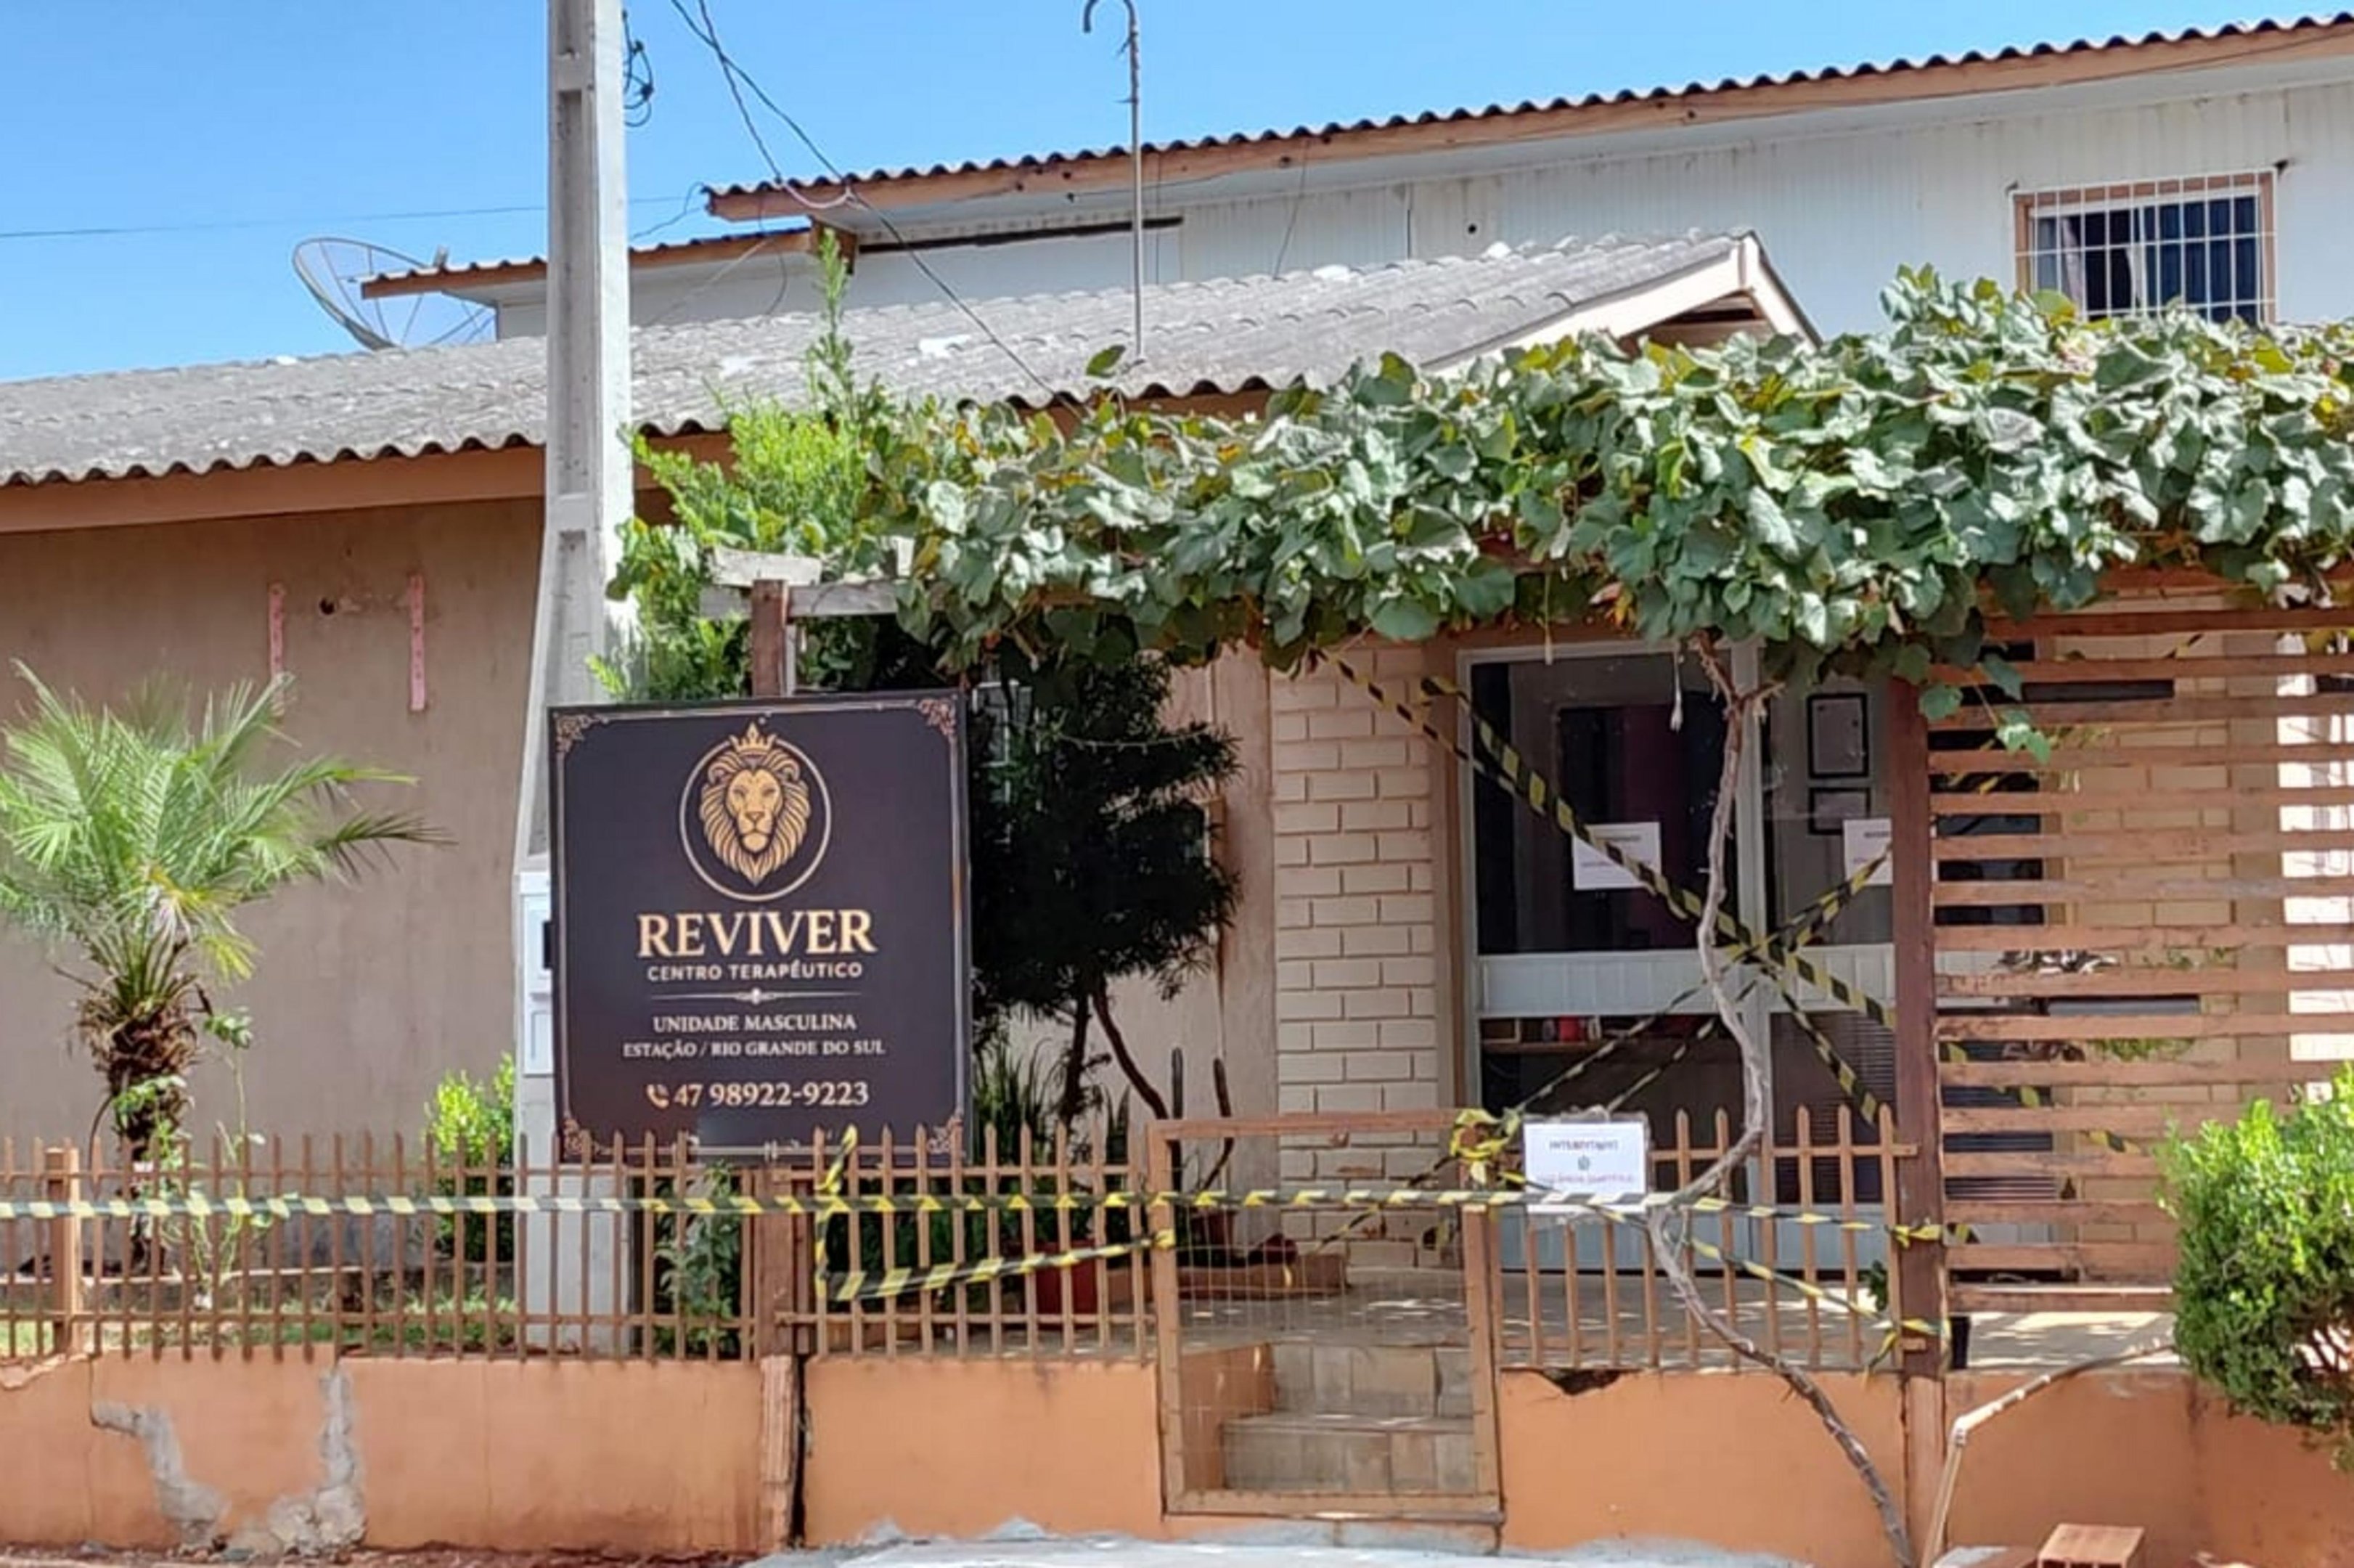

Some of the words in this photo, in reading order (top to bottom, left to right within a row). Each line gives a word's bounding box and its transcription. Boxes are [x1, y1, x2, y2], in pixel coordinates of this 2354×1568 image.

[637, 909, 878, 957] REVIVER
[647, 965, 722, 981] CENTRO
[653, 1016, 740, 1033] UNIDADE
[744, 1013, 857, 1032] MASCULINA
[622, 1039, 698, 1059] ESTAÇÃO
[711, 1042, 742, 1056] RIO
[745, 1041, 818, 1056] GRANDE
[822, 1041, 850, 1055] DO
[853, 1039, 886, 1055] SUL
[674, 1083, 704, 1107] 47
[708, 1081, 870, 1107] 98922-9223
